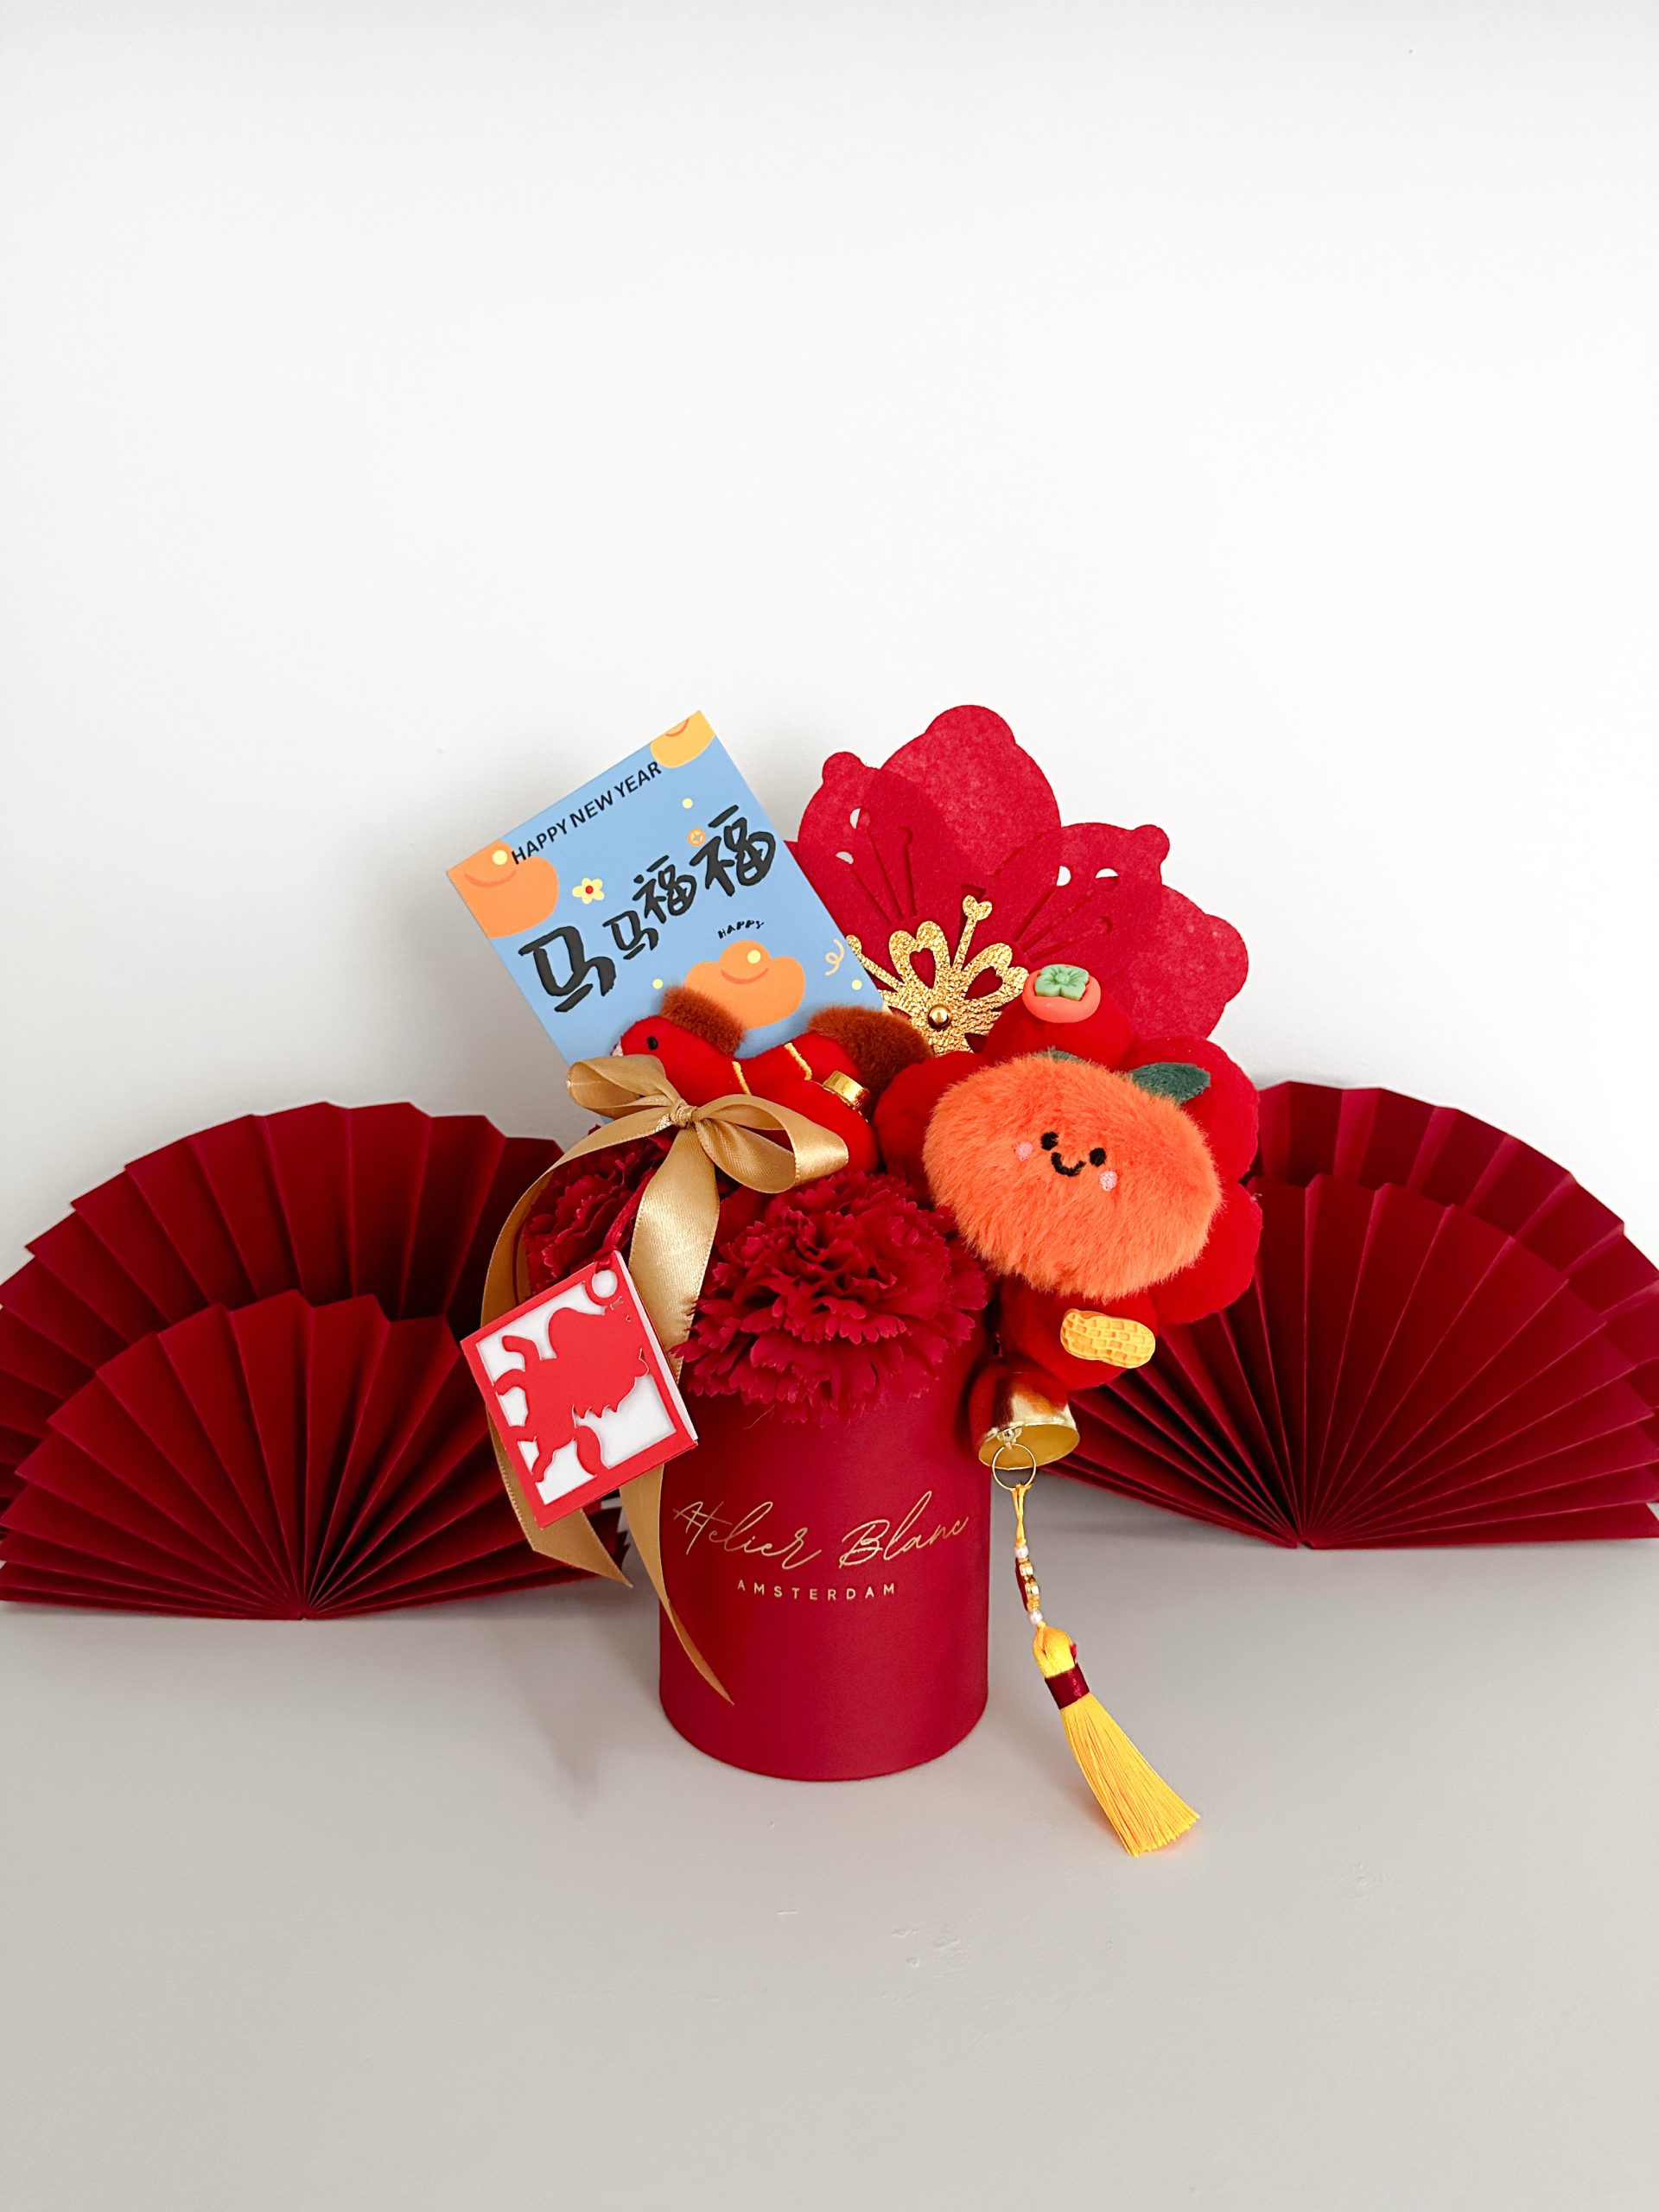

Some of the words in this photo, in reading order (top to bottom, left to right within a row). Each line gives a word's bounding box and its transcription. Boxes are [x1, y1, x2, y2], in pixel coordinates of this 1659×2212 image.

[512, 818, 568, 865] HAPPY
[569, 790, 613, 828] NEW
[613, 761, 662, 798] YEAR
[518, 804, 776, 1012] 马马福福
[673, 1500, 822, 1570] Atelier
[838, 1491, 969, 1569] Blanc
[737, 1579, 895, 1601] AMSTERDAM
